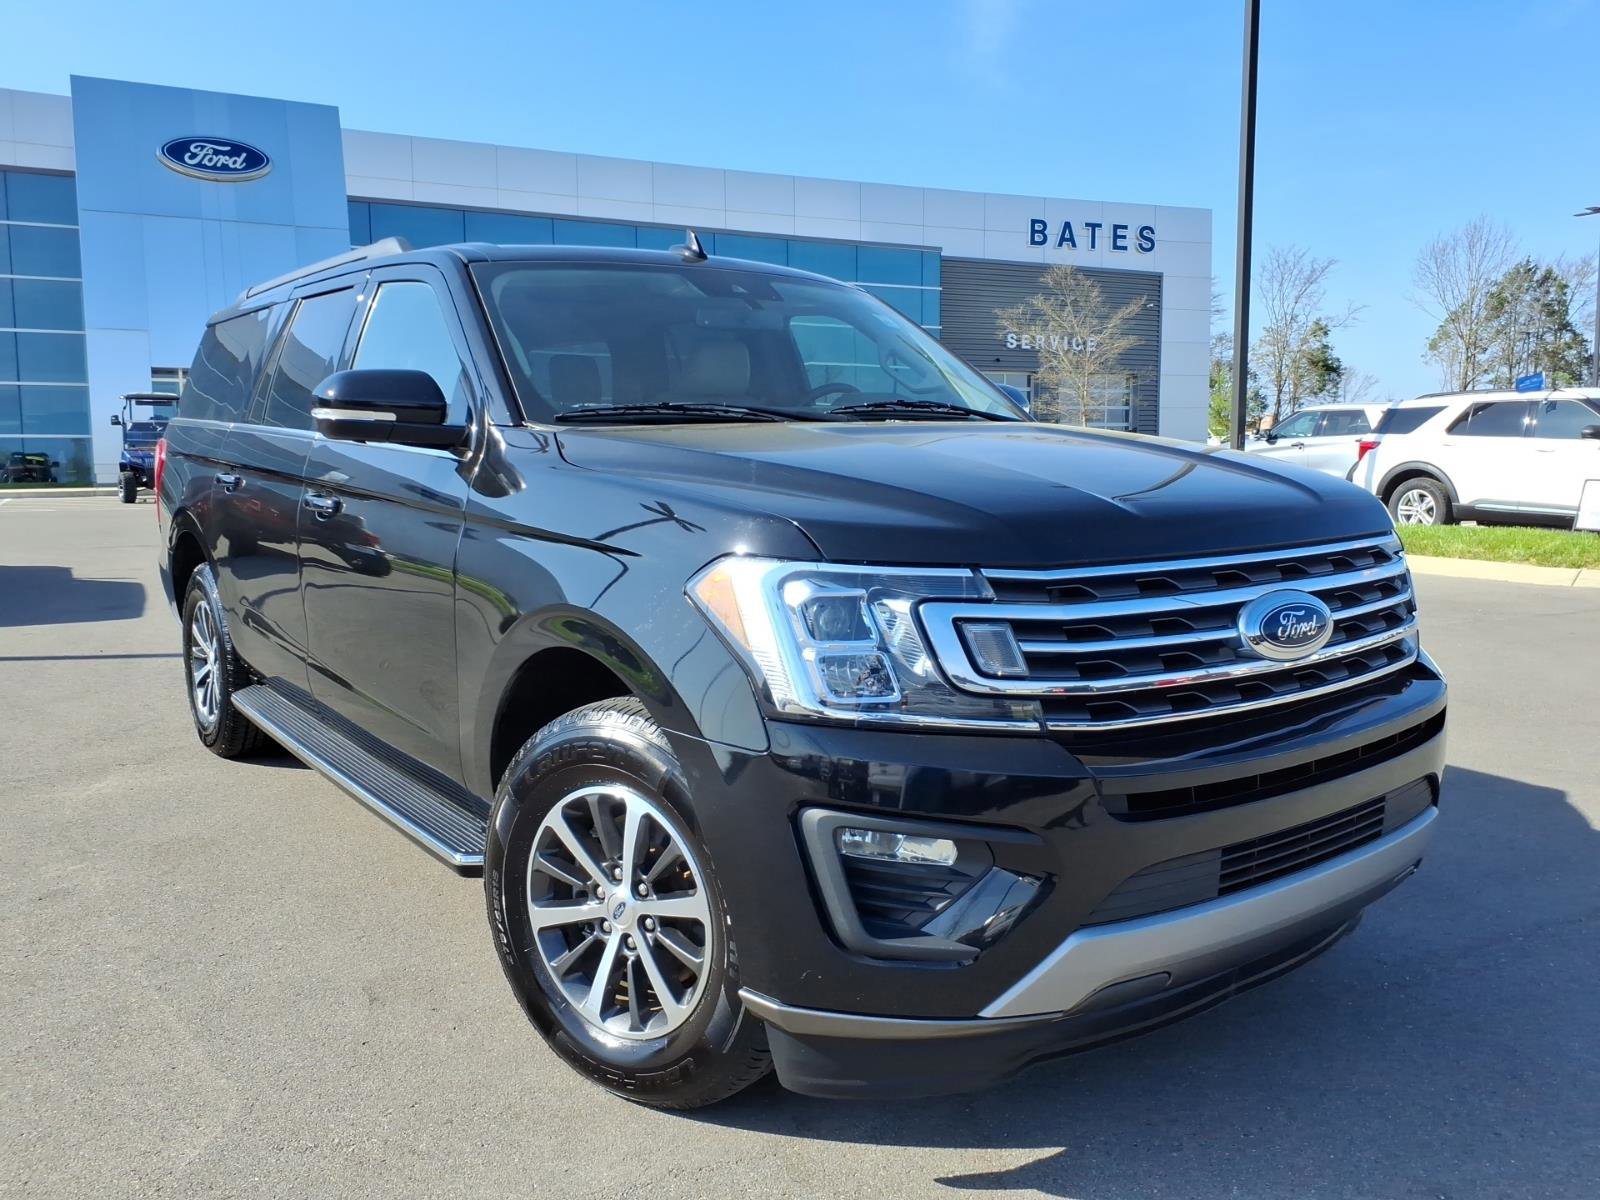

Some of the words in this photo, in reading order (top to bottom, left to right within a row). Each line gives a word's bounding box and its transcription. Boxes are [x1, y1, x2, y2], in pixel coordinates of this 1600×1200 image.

[184, 142, 247, 169] Ford
[1029, 218, 1156, 253] BATES
[1006, 333, 1098, 352] SERVICE
[1277, 609, 1319, 641] Ford
